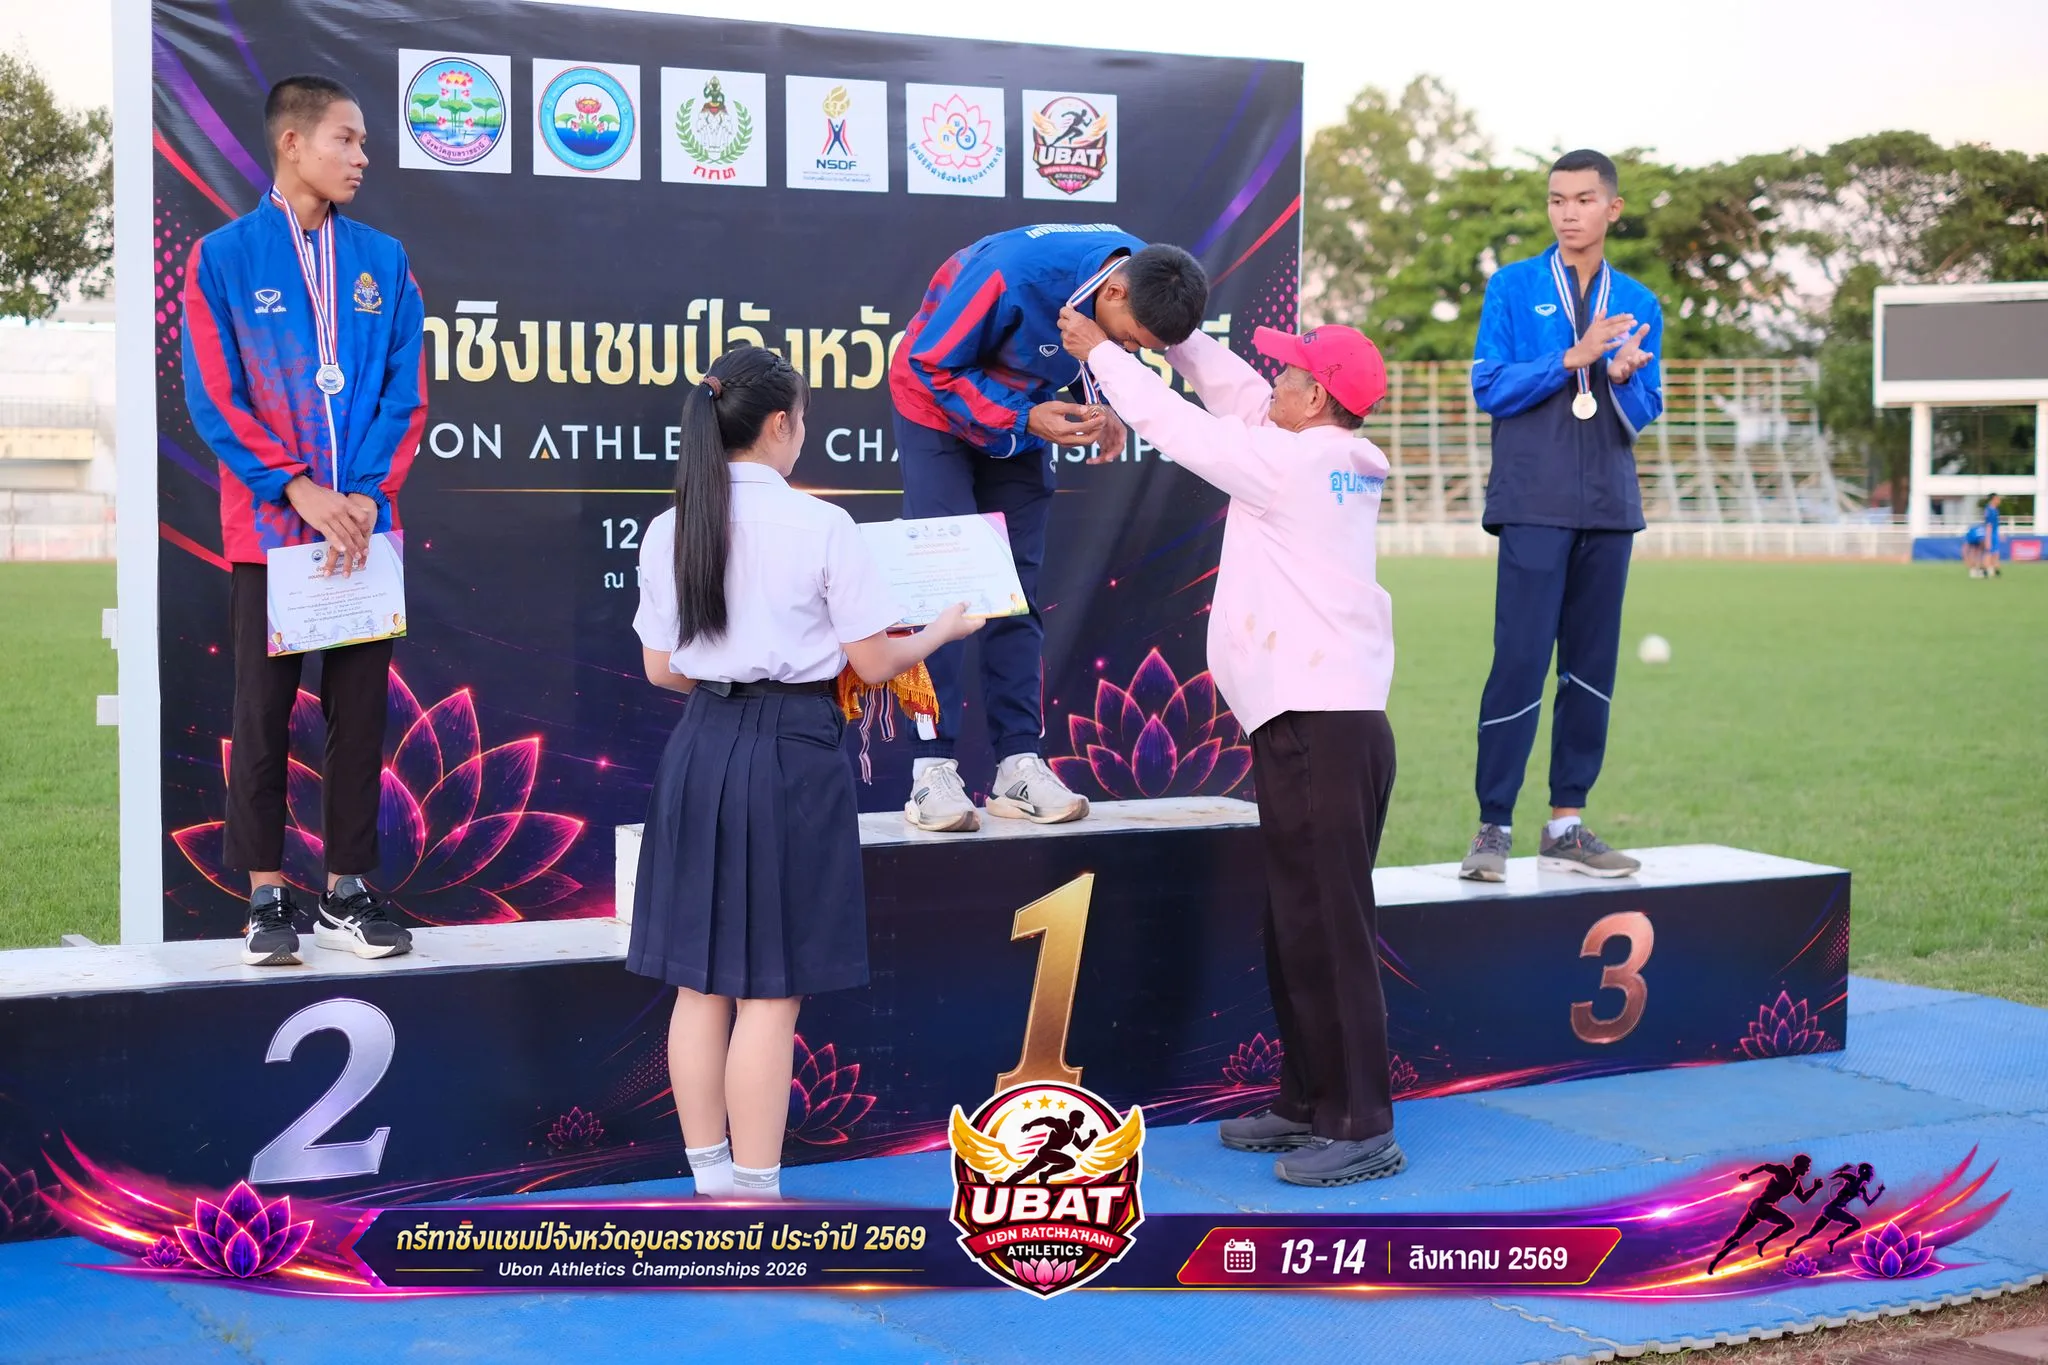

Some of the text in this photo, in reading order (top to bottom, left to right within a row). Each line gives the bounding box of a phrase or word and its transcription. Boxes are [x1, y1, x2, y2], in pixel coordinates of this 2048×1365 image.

[816, 159, 857, 170] NSDF
[1038, 146, 1104, 167] UBAT
[414, 422, 501, 459] ON
[602, 518, 639, 549] 12
[604, 572, 624, 588] ณ
[994, 873, 1095, 1094] 1
[1570, 911, 1655, 1044] 3
[249, 997, 396, 1184] 2
